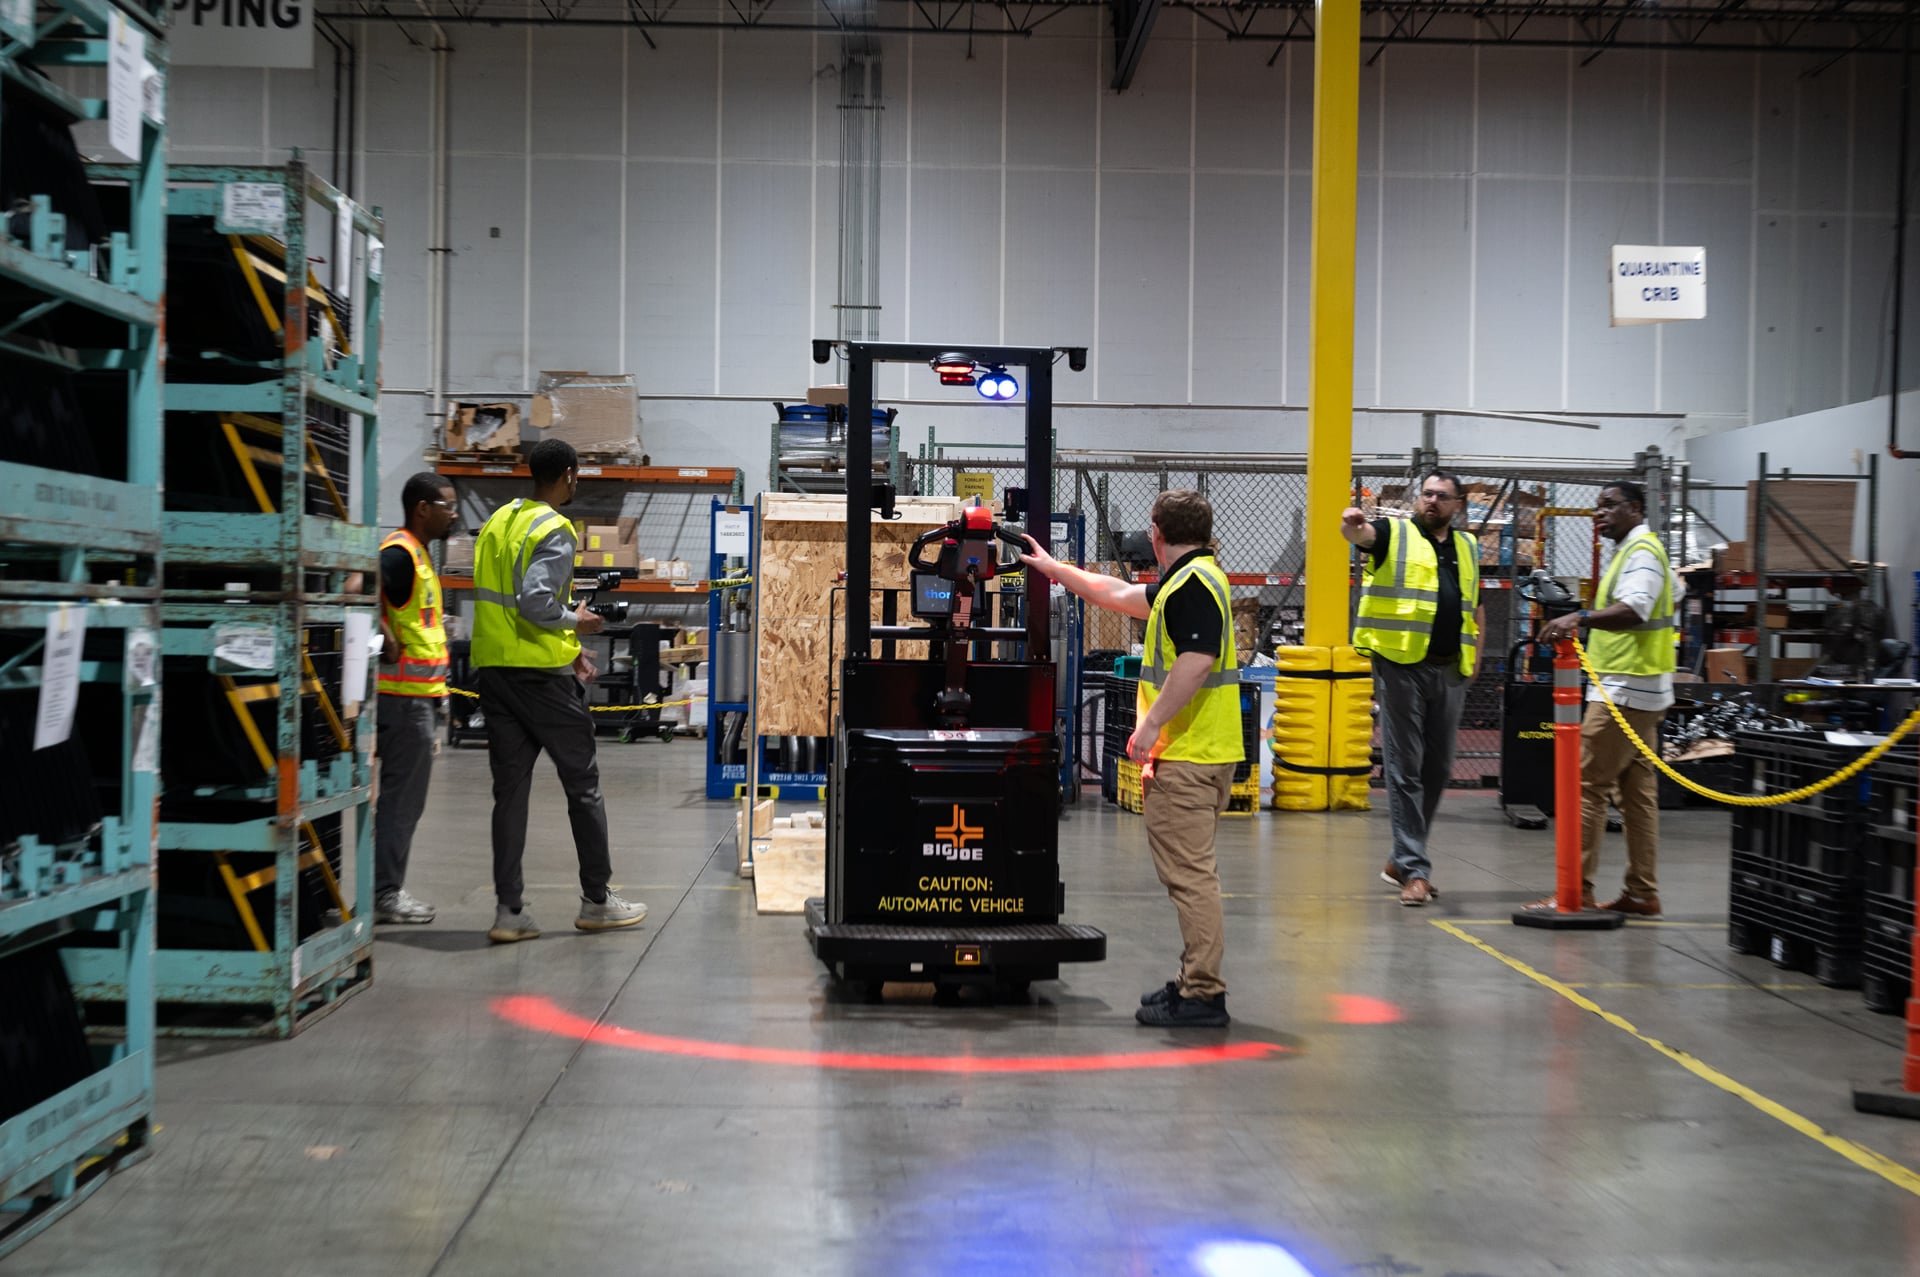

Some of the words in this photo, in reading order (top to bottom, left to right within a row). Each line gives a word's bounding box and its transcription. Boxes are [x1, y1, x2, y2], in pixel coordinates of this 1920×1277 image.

[1618, 262, 1701, 276] QUARANTINE
[1642, 287, 1680, 301] CRIB
[923, 843, 953, 856] BIG
[946, 848, 983, 861] JOE
[919, 876, 993, 891] CAUTION:
[878, 896, 963, 912] AUTOMATIC
[970, 897, 1024, 913] VEHICLE
